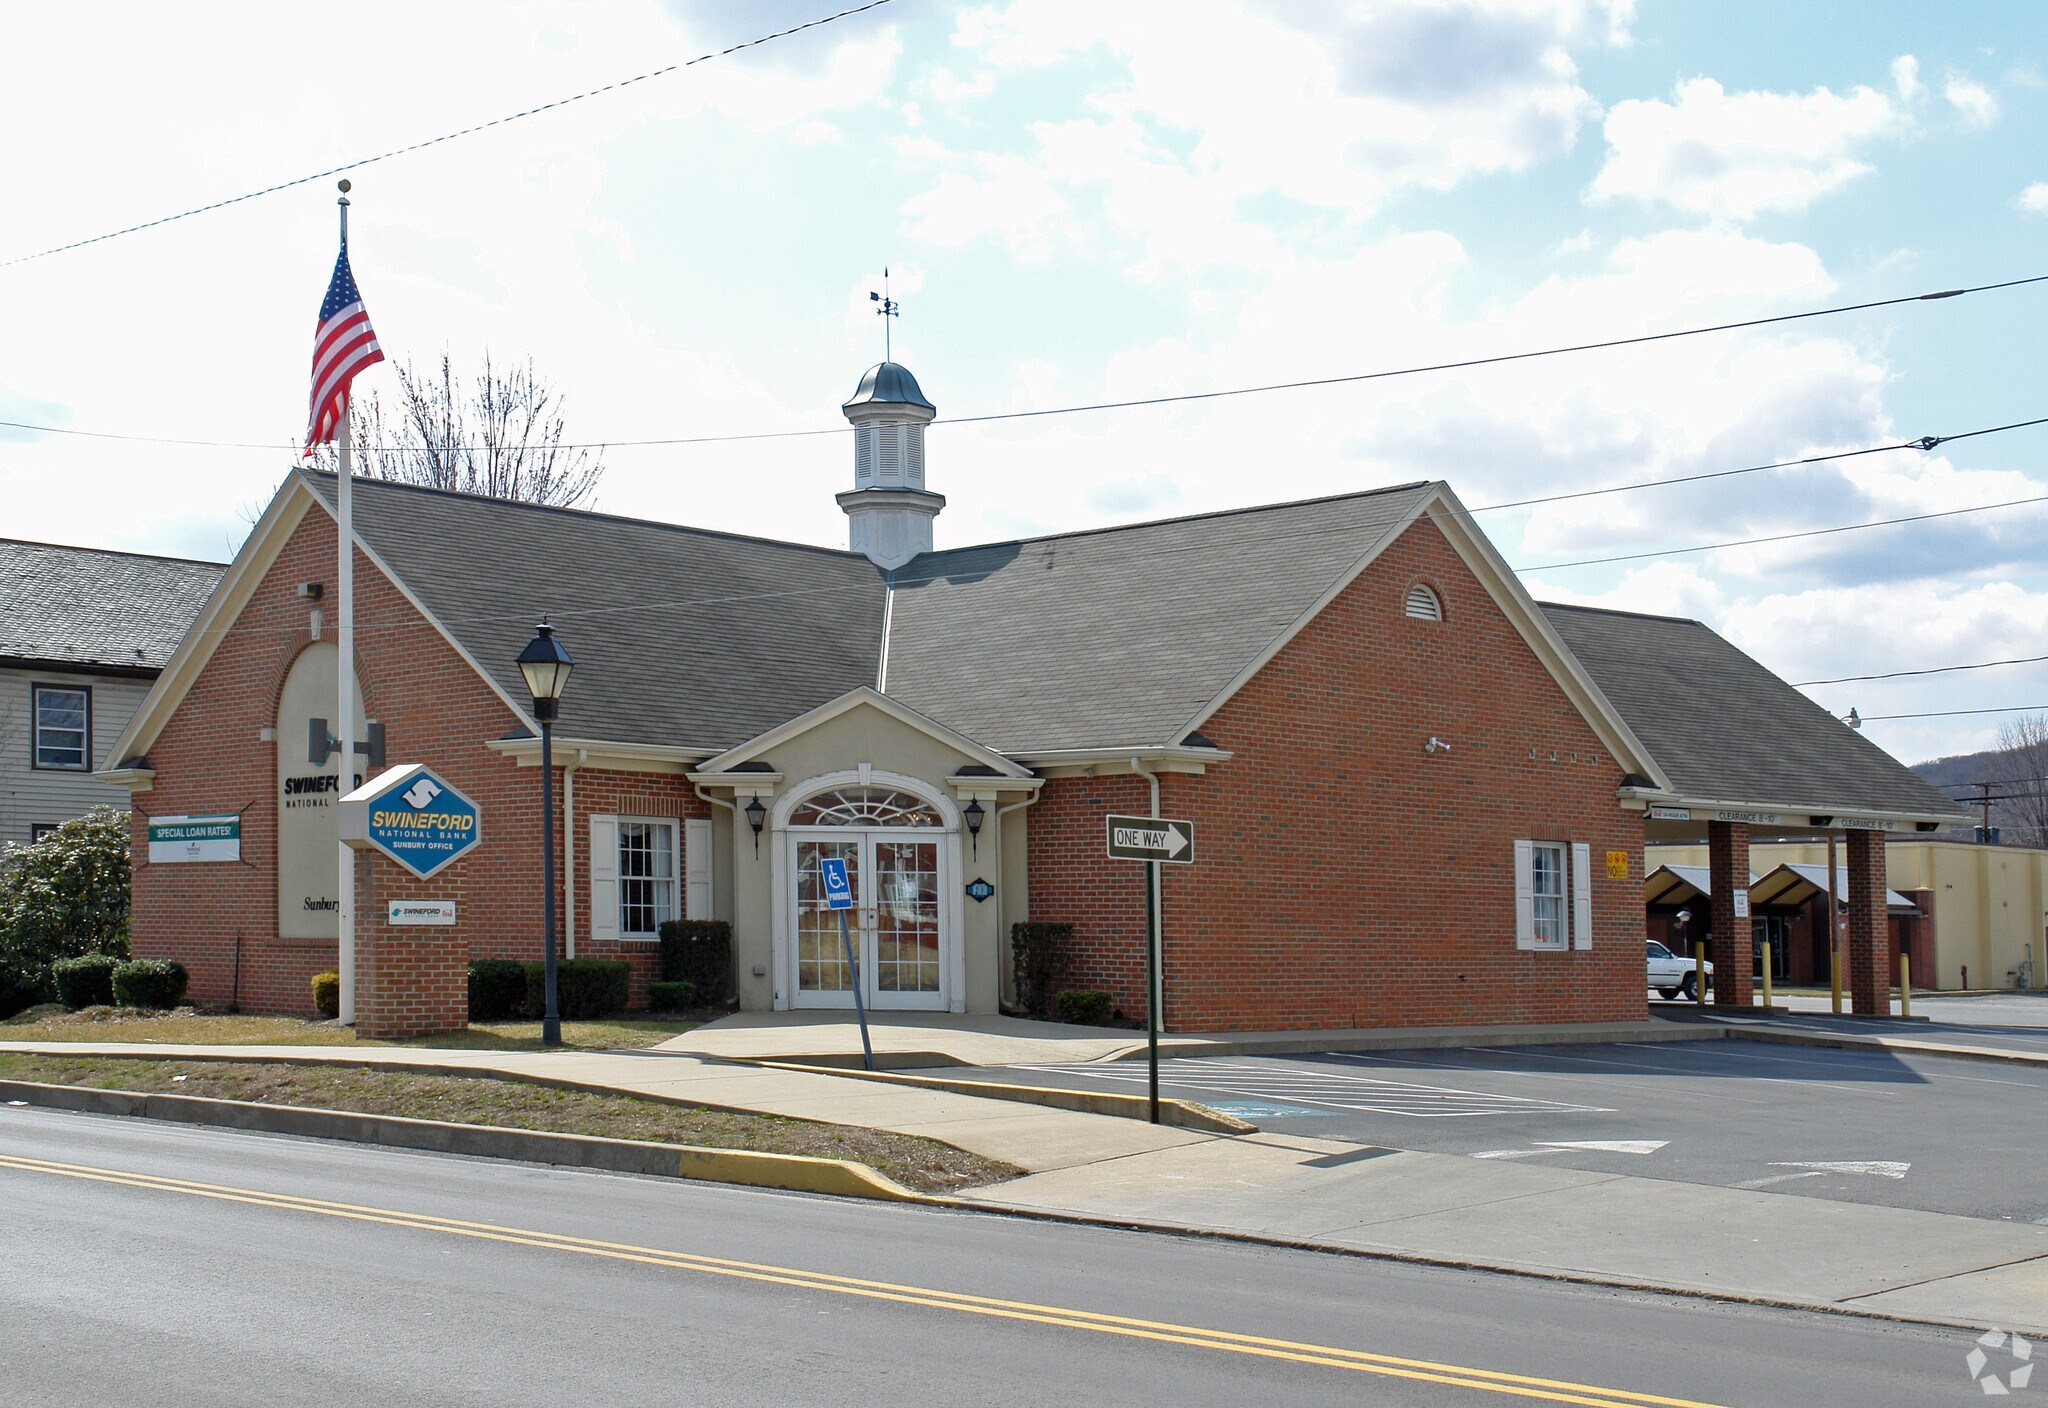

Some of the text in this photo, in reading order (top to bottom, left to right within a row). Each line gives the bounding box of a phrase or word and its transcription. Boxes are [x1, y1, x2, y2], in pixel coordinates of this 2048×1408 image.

[284, 774, 362, 794] SWINEFOD
[286, 798, 329, 809] NATIONAL
[372, 810, 474, 831] SWINEFORD
[1719, 811, 1757, 822] CLEARANCE
[1841, 819, 1876, 829] CLEARANCE
[157, 825, 232, 838] SPECIAL LOAN RATES!
[379, 829, 468, 840] NATIONAL BANK
[1116, 829, 1167, 848] ONE WAY
[392, 841, 454, 850] SUNBURY OFFICE
[1607, 865, 1617, 878] NO
[829, 892, 850, 900] PARKING
